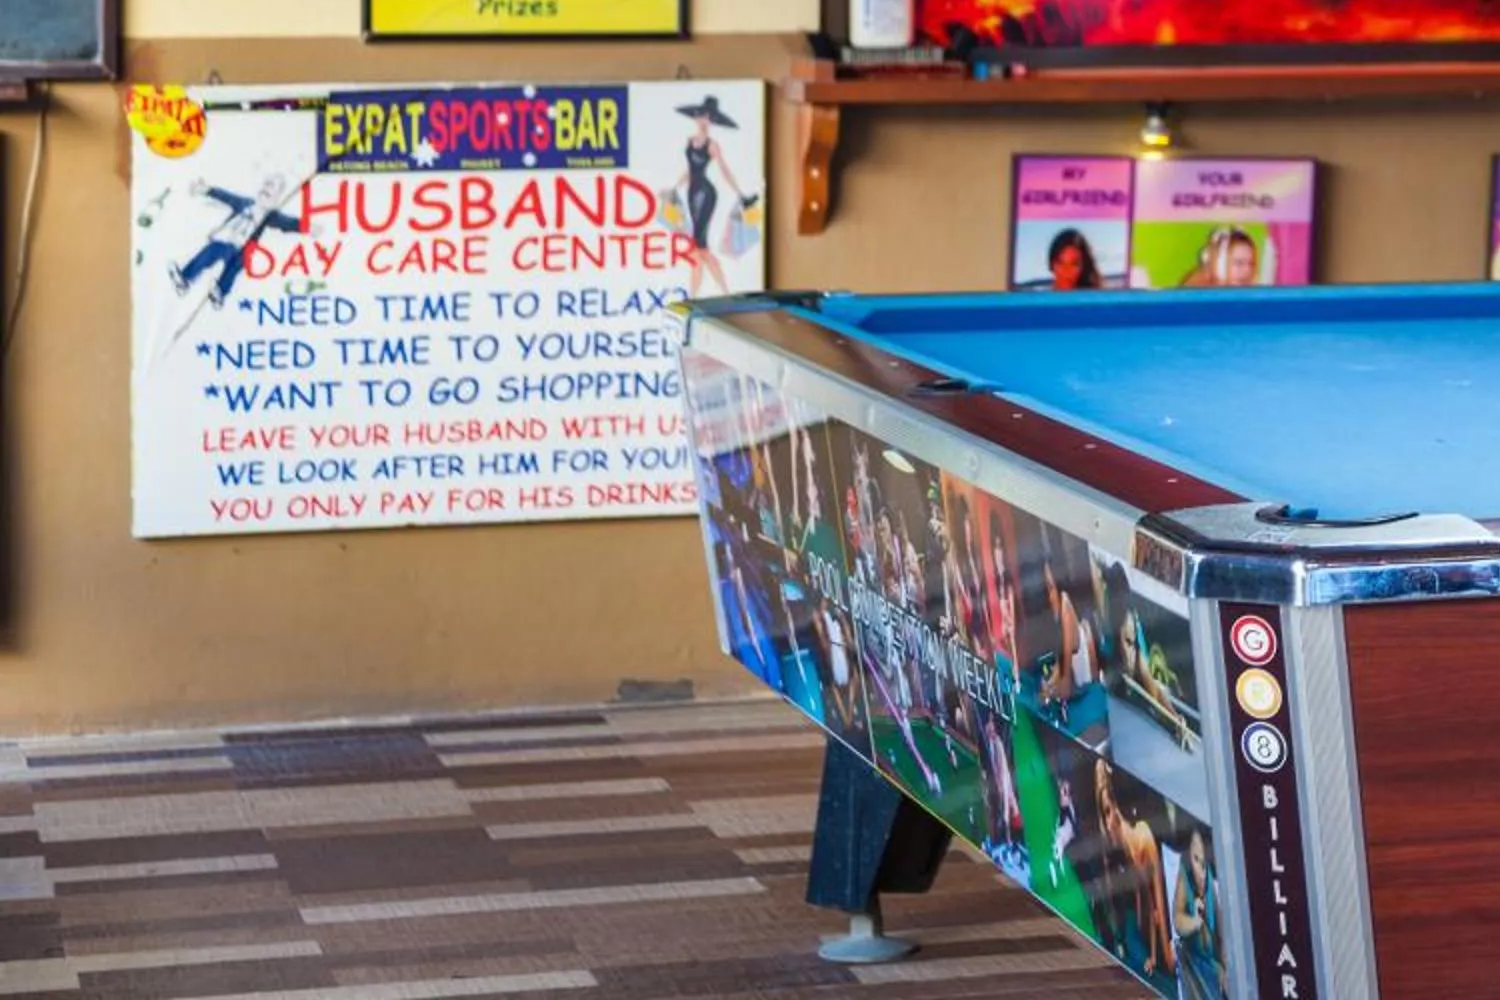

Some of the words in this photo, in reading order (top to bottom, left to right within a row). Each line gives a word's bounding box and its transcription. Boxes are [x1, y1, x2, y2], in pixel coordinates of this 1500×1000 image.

[325, 102, 424, 155] EXPAT
[428, 98, 548, 151] SPORTS
[555, 98, 619, 149] BAR
[1062, 168, 1086, 181] MY
[1198, 171, 1243, 186] YOUR
[300, 174, 657, 235] HUSBAND
[1022, 188, 1127, 206] GIRLFRIEND
[1172, 193, 1275, 209] GIRLFRIEND
[242, 240, 341, 280] DAY
[367, 235, 488, 275] CARE
[512, 231, 698, 272] CENTER
[375, 292, 471, 322] TIME
[490, 292, 540, 319] TO
[333, 335, 430, 366] TIME
[449, 334, 499, 362] TO
[359, 379, 411, 406] TO
[429, 377, 480, 405] GO
[497, 370, 680, 403] SHOPPING
[202, 425, 296, 453] LEAVE
[309, 422, 390, 448] YOUR
[404, 418, 547, 445] HUSBAND
[562, 415, 645, 440] WITH
[217, 461, 265, 486] WE
[279, 458, 357, 484] LOOK
[372, 454, 465, 479] AFTER
[479, 452, 540, 475] HIM
[552, 449, 609, 473] FOR
[210, 497, 273, 521] YOU
[287, 493, 366, 519] ONLY
[380, 491, 434, 514] PAY
[448, 488, 505, 513] FOR
[519, 485, 574, 509] HIS
[587, 481, 697, 507] DRINKS
[948, 632, 1018, 725] WEEKLY
[1257, 735, 1273, 759] 8
